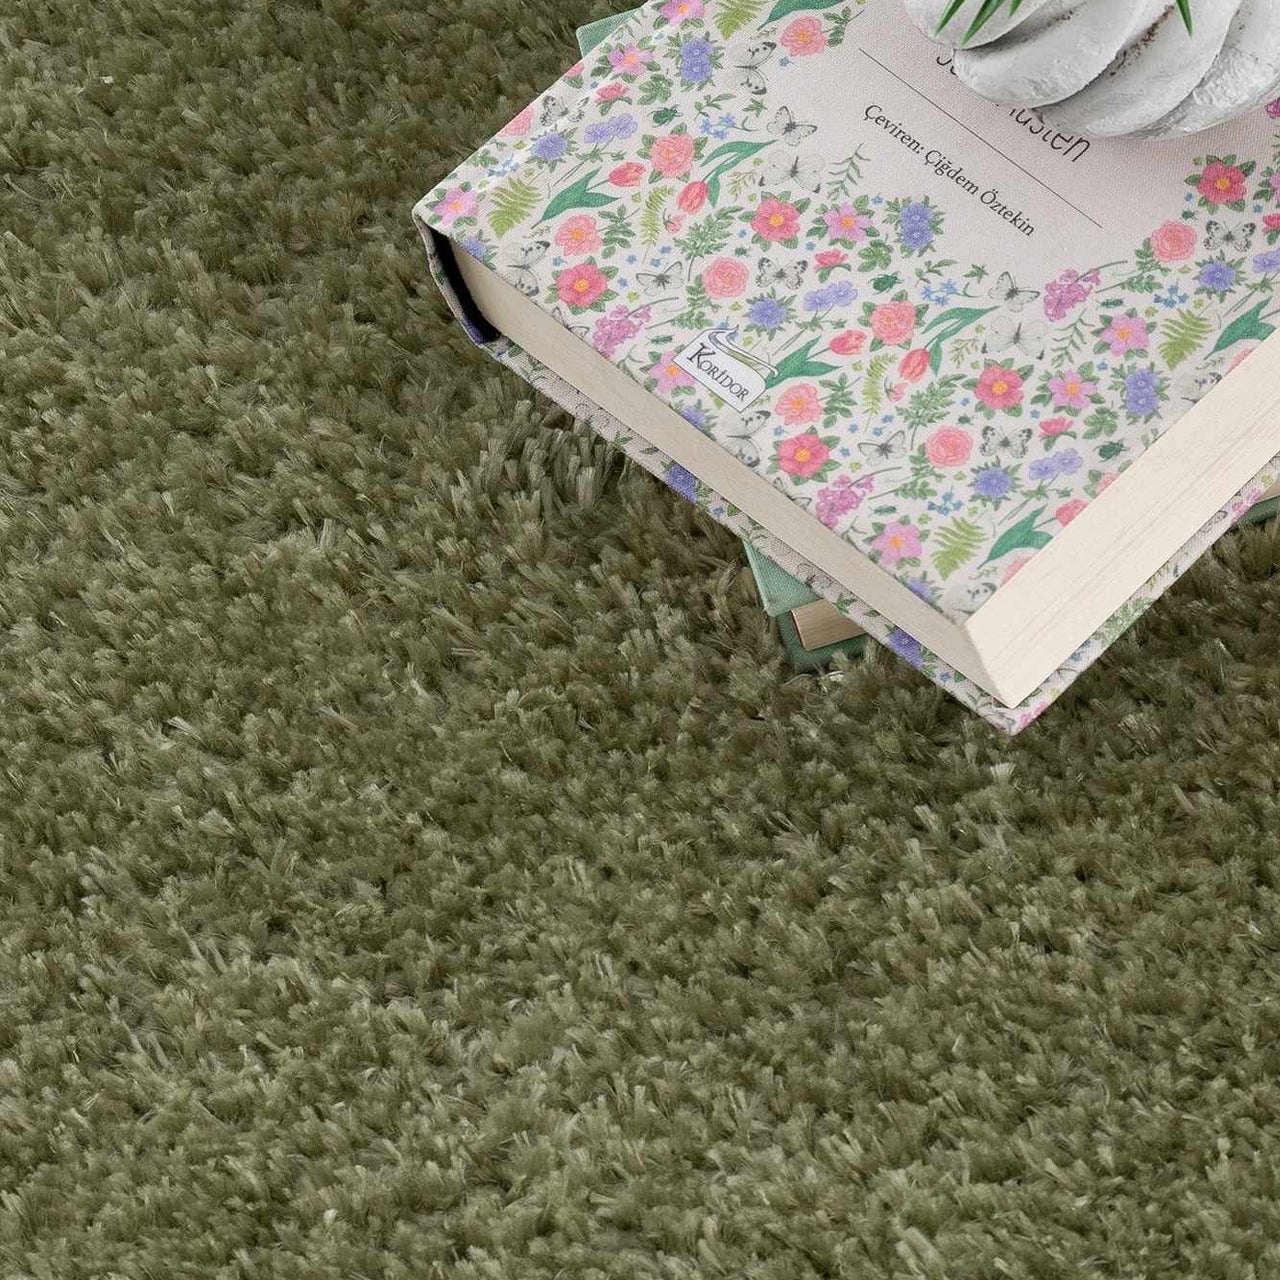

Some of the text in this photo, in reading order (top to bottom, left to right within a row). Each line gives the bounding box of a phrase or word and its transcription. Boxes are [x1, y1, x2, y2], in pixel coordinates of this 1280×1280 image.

[863, 104, 1035, 237] Çeviren: Çiğdem Öztekin
